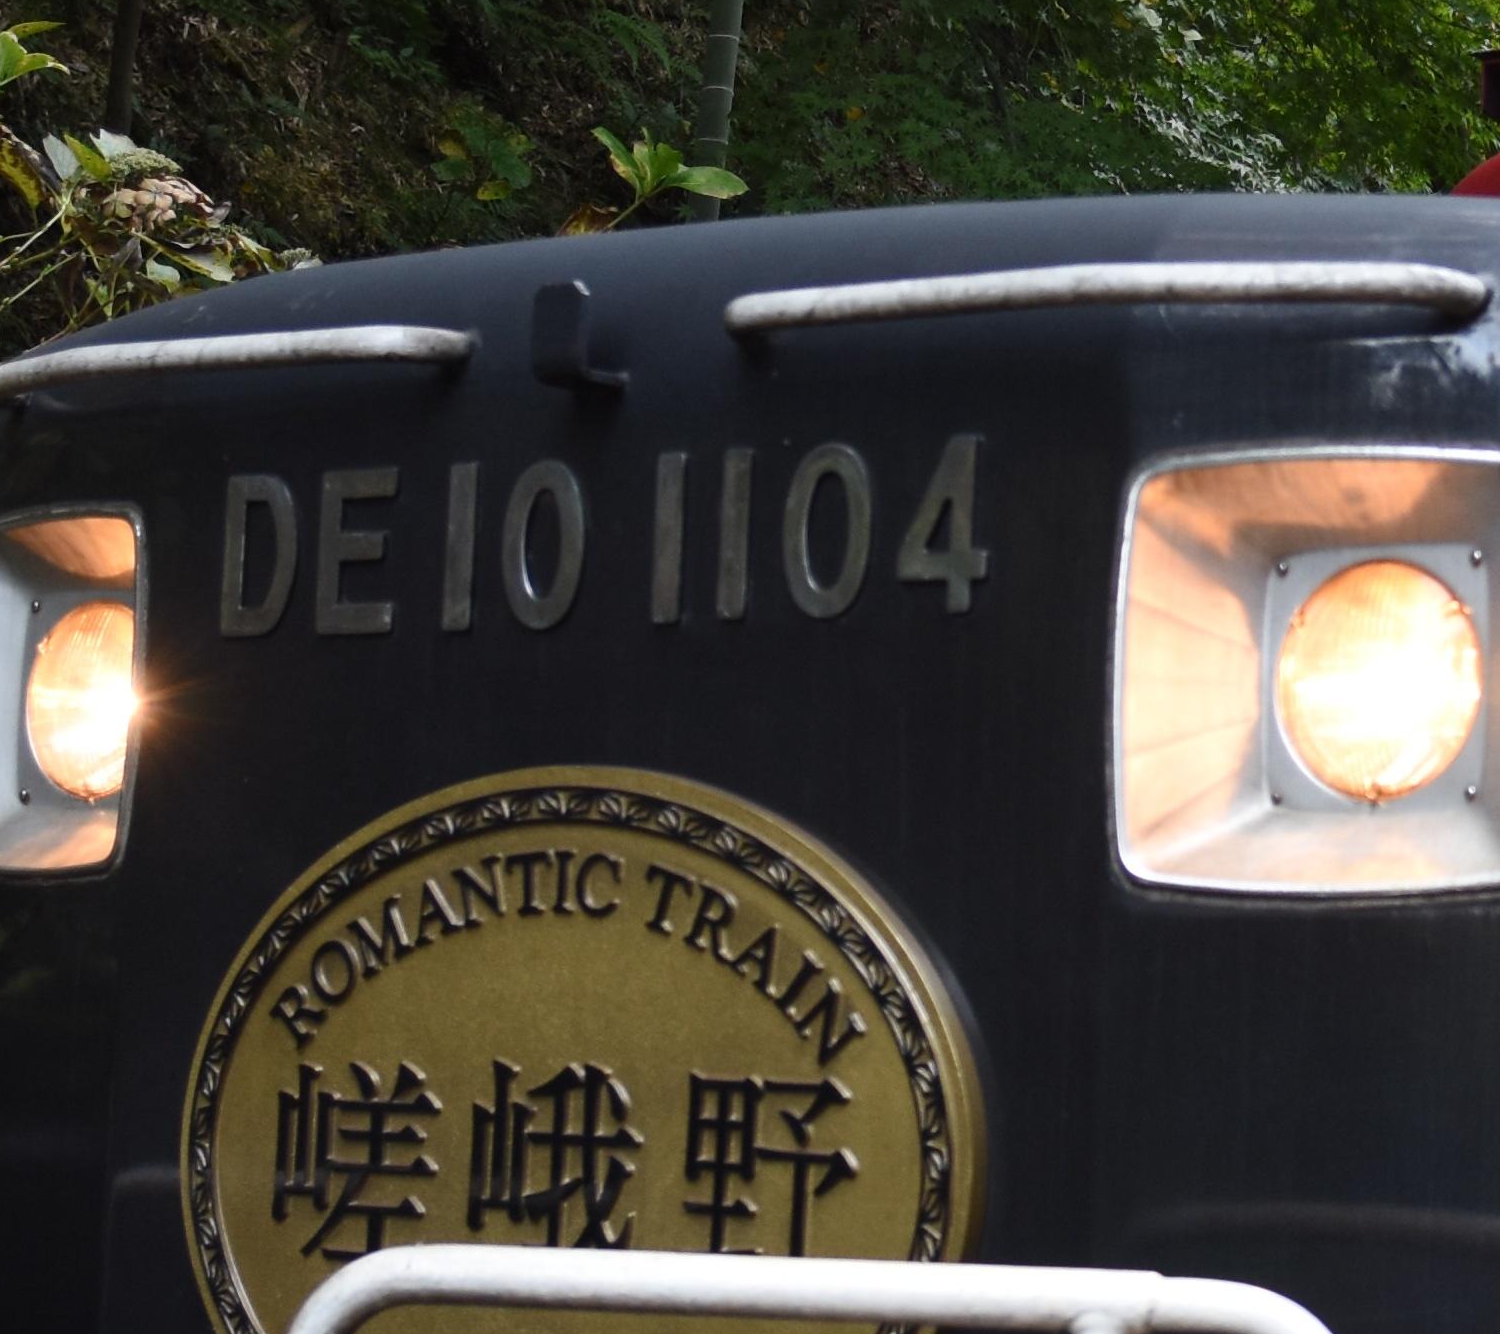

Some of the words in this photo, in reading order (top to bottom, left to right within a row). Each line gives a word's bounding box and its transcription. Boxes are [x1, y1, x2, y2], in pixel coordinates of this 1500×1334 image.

[650, 433, 989, 626] 1104
[269, 847, 625, 1050] ROMANTIC
[645, 863, 869, 1067] TRAIN
[270, 1058, 861, 1261] 嵯峨野
